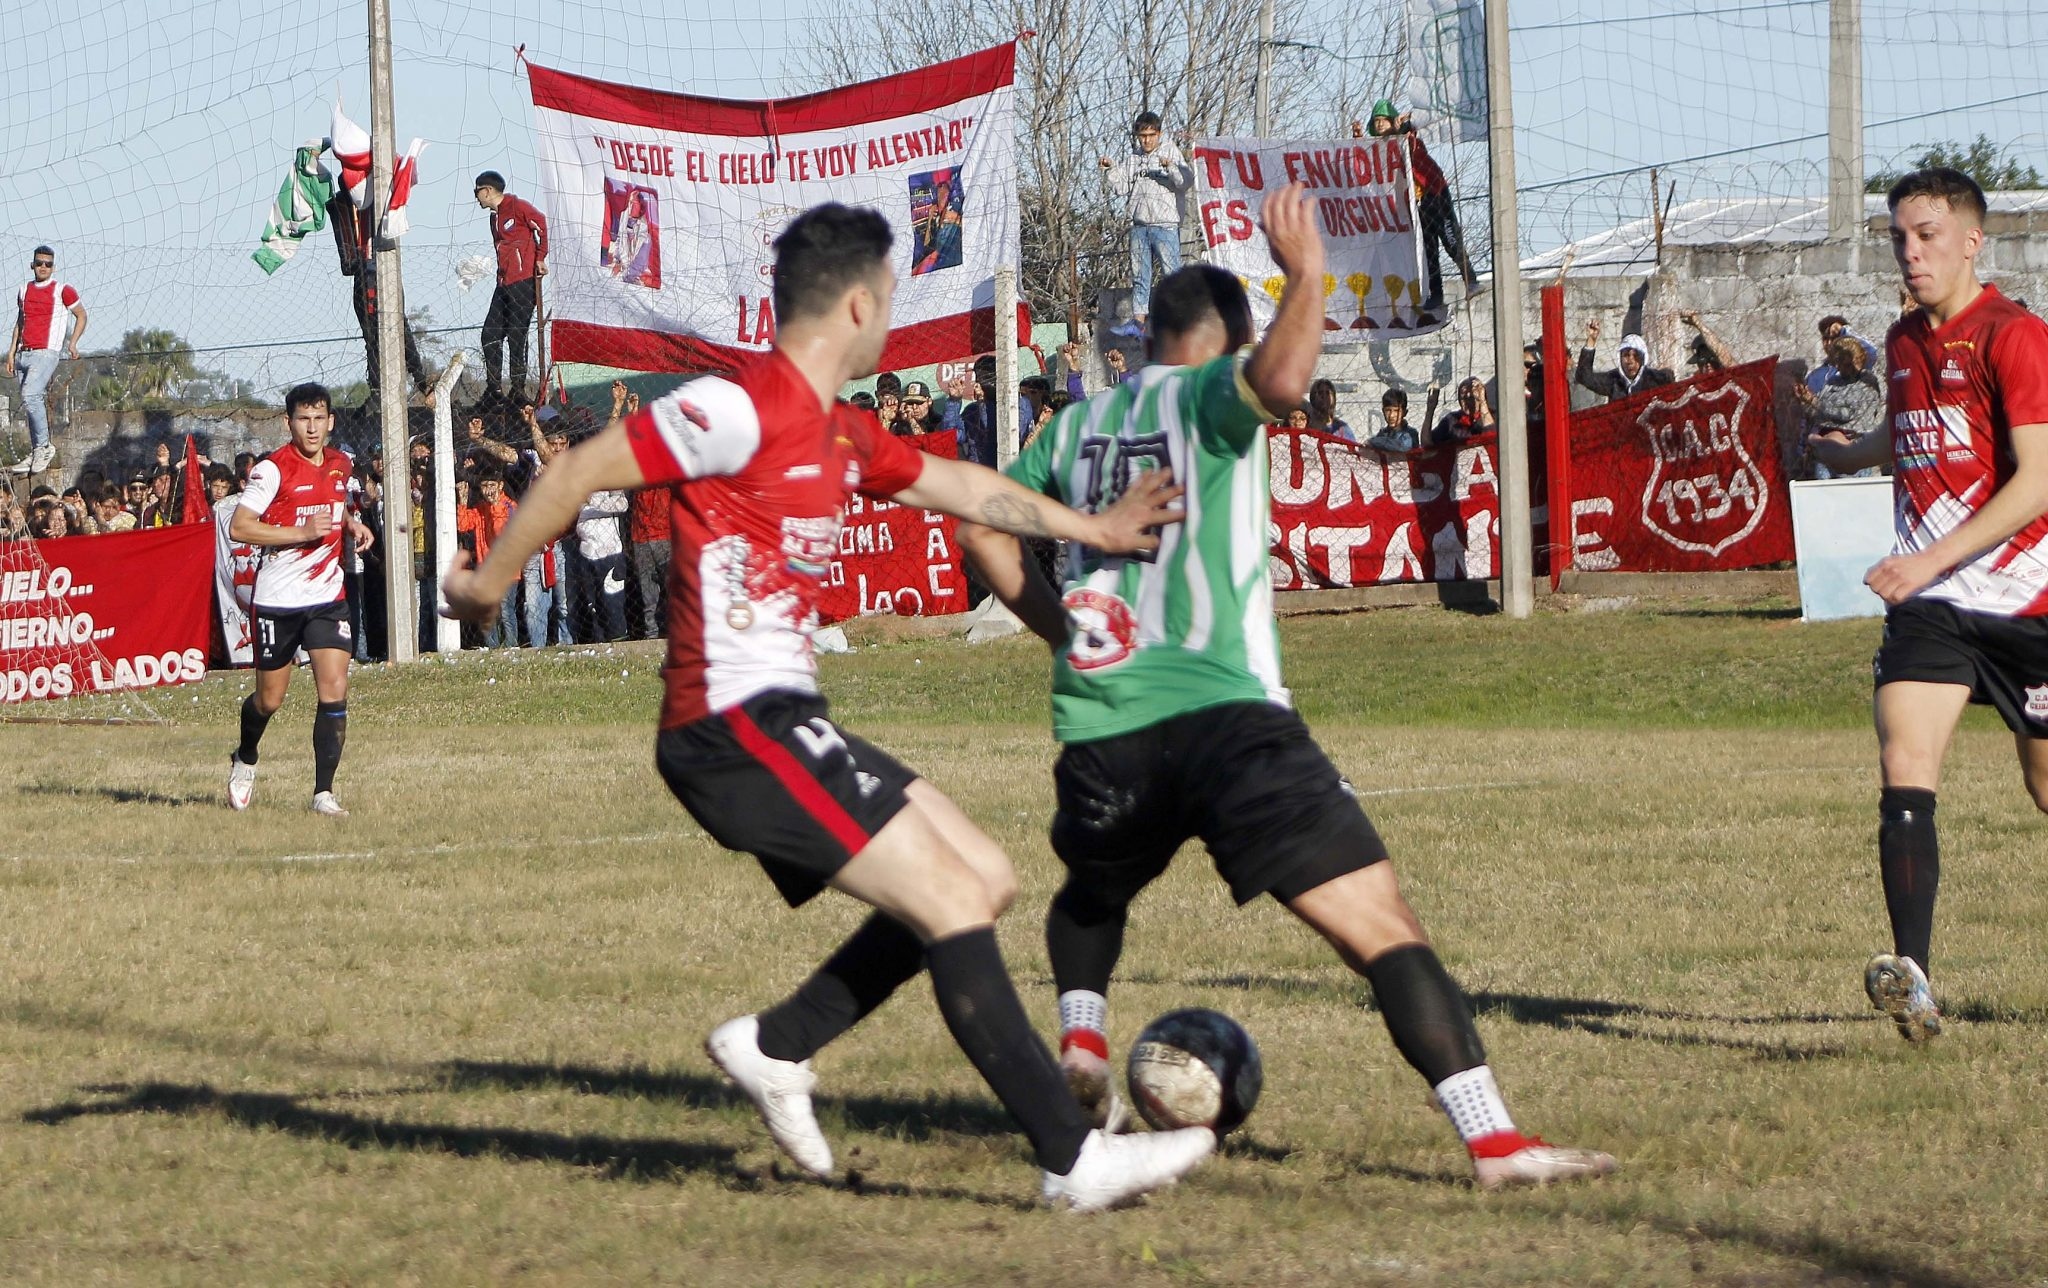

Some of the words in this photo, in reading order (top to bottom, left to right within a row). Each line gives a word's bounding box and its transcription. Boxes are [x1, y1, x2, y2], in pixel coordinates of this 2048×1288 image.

[686, 150, 710, 183] EL
[718, 152, 775, 185] CIELO
[786, 149, 810, 182] TE
[814, 142, 857, 179] VOY
[1194, 146, 1264, 191] TU
[1284, 138, 1407, 189] ENVIDIA
[1200, 199, 1254, 249] ES
[1320, 188, 1410, 238] ORGULL
[1656, 467, 1756, 525] 1934
[0, 612, 116, 651] IERNO...
[91, 648, 206, 691] LADOS
